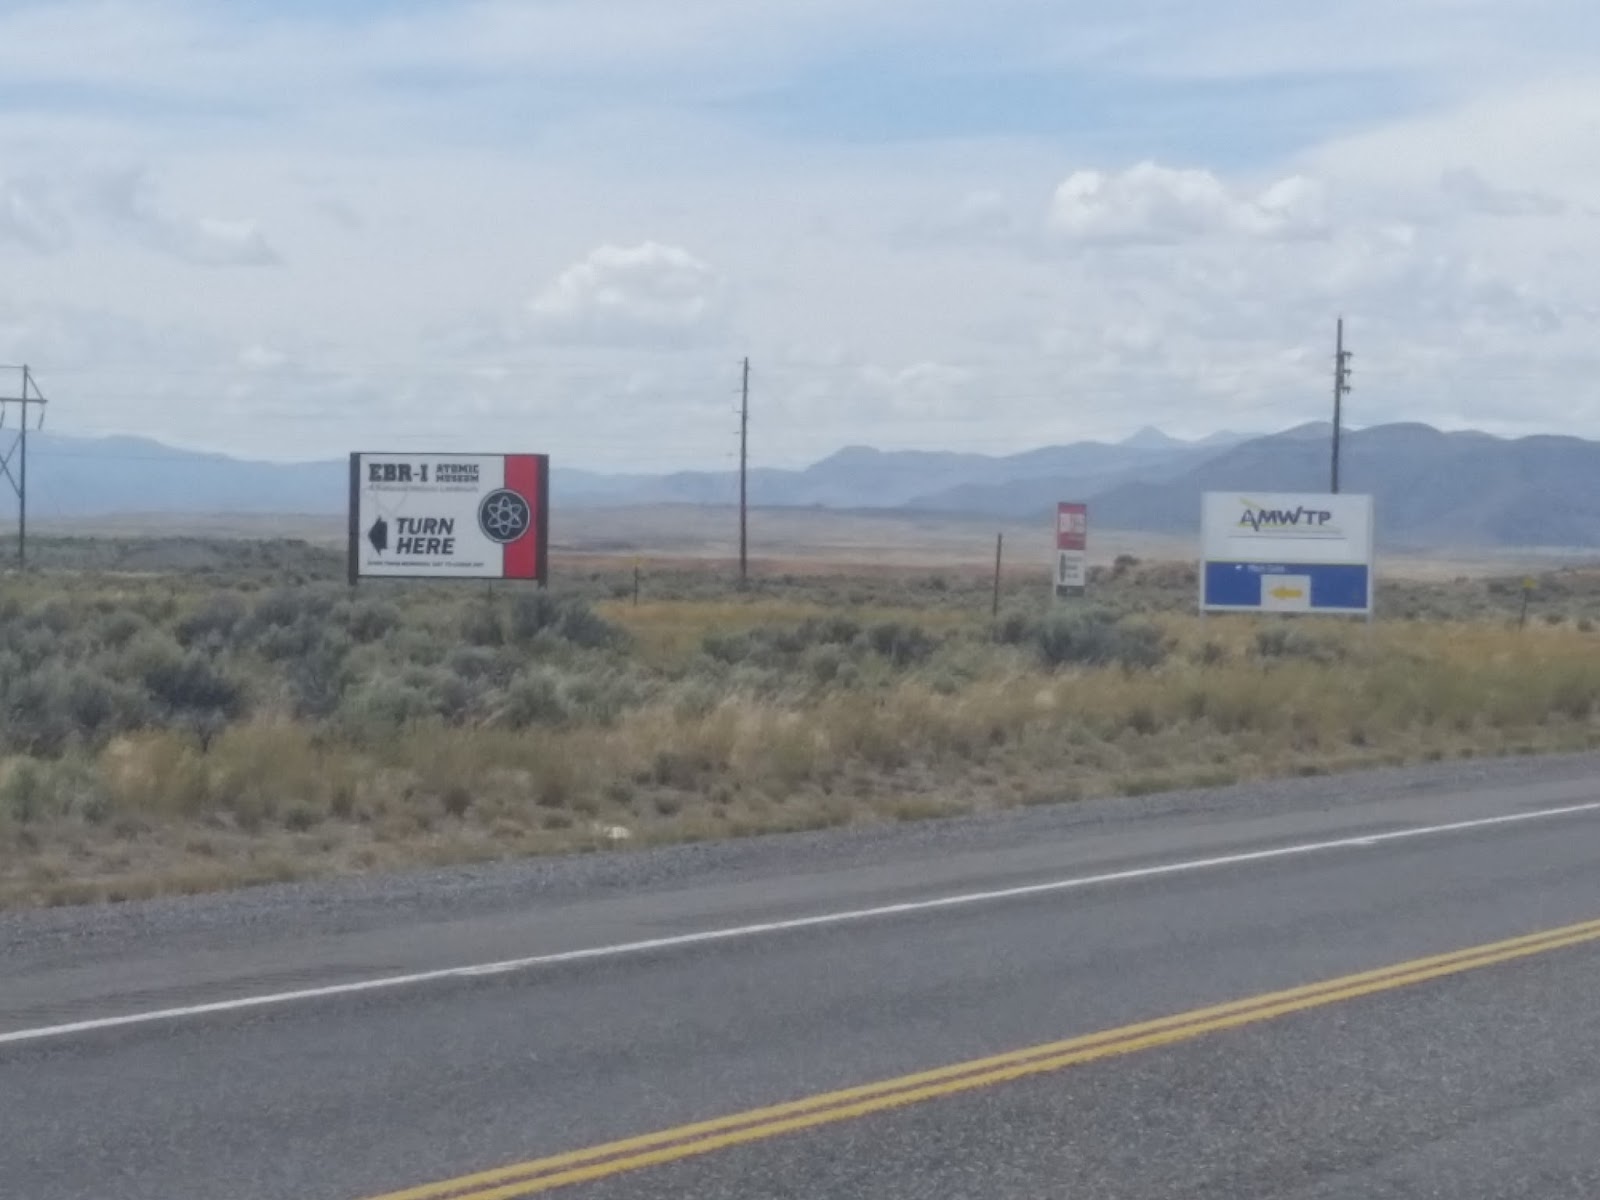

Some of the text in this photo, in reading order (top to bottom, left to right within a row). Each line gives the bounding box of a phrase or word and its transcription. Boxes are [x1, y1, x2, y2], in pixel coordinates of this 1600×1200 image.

[369, 463, 428, 482] EBR-I
[436, 464, 479, 473] ATOMIC
[436, 474, 479, 482] MUSEUM
[397, 518, 455, 535] TURN
[1239, 505, 1332, 531] AMWTP
[396, 537, 455, 554] HERE
